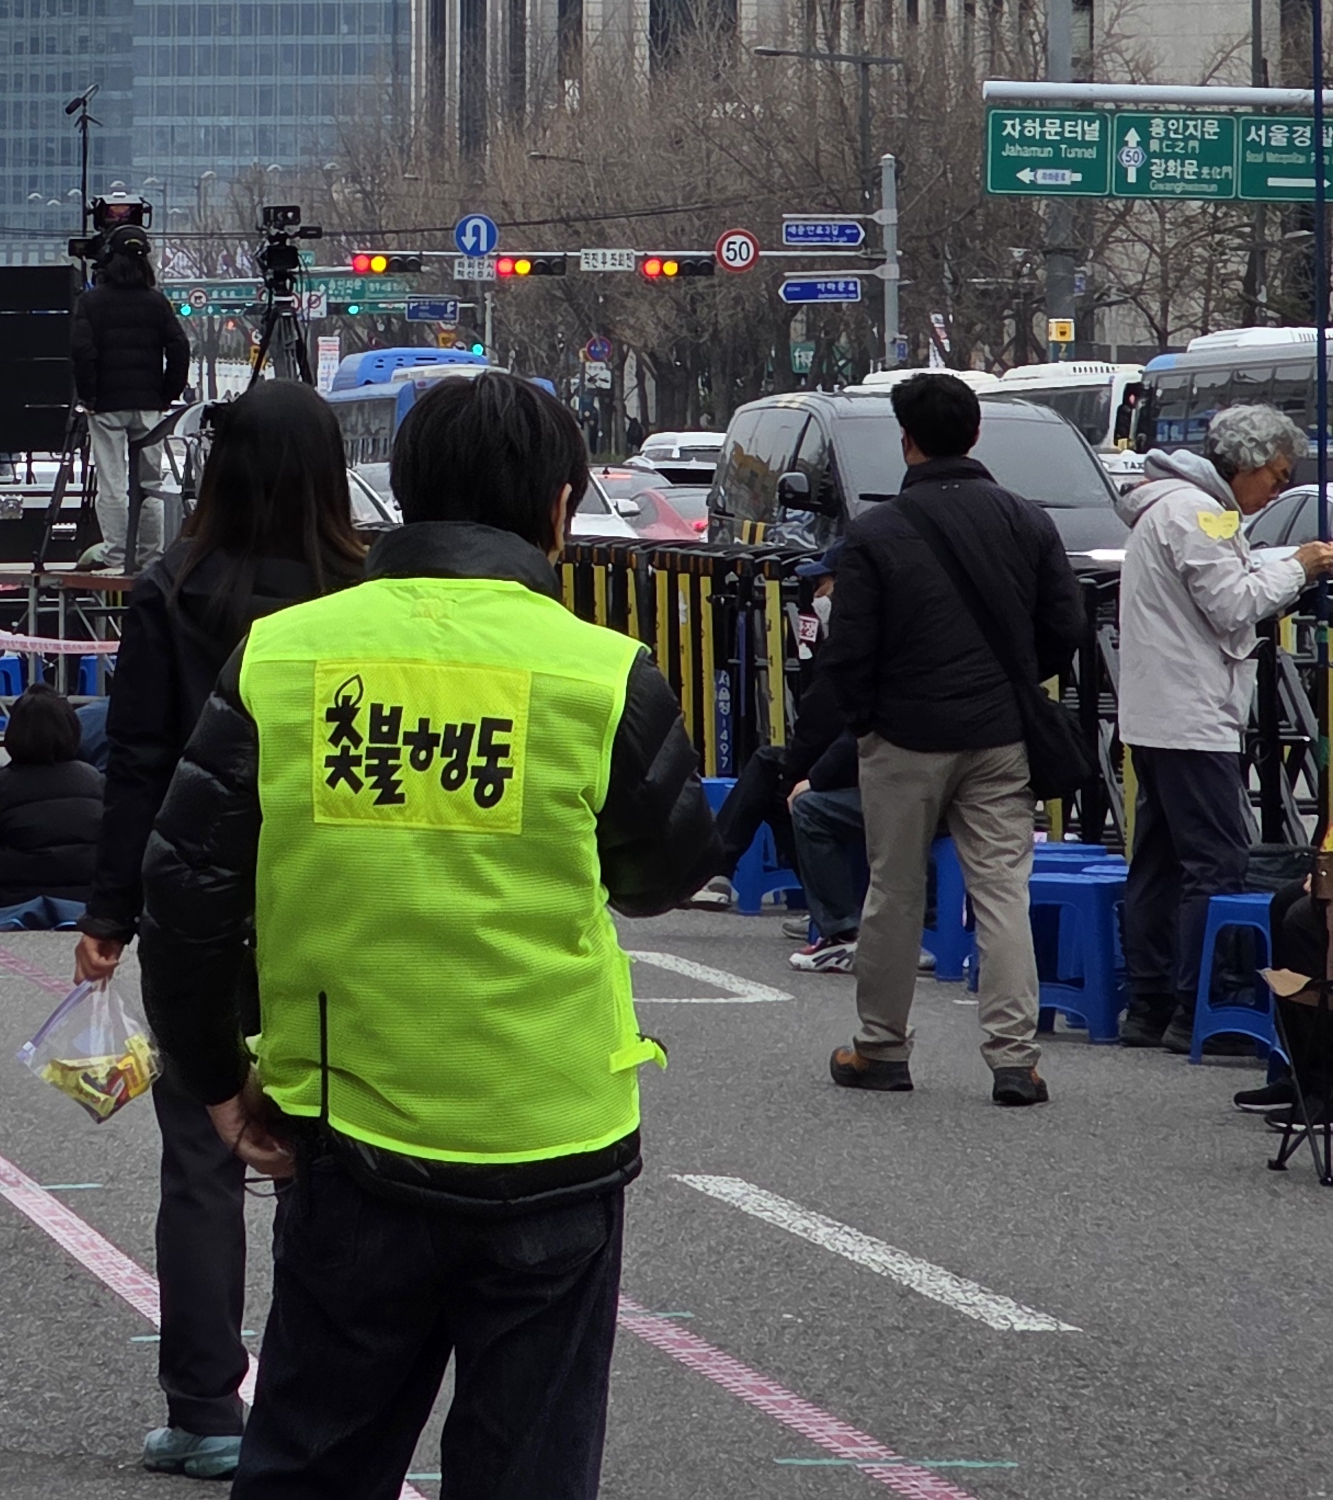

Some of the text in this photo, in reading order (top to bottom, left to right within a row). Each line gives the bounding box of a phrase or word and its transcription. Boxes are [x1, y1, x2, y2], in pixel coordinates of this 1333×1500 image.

[1002, 118, 1101, 141] 자하문터널
[1149, 118, 1220, 140] 흥인지문
[1002, 143, 1097, 160] Jahamun Tunnel
[1124, 151, 1140, 164] 50
[1150, 159, 1199, 180] 광화문
[725, 240, 751, 262] 50
[1123, 461, 1145, 470] TAX
[324, 693, 515, 809] 촛불행동
